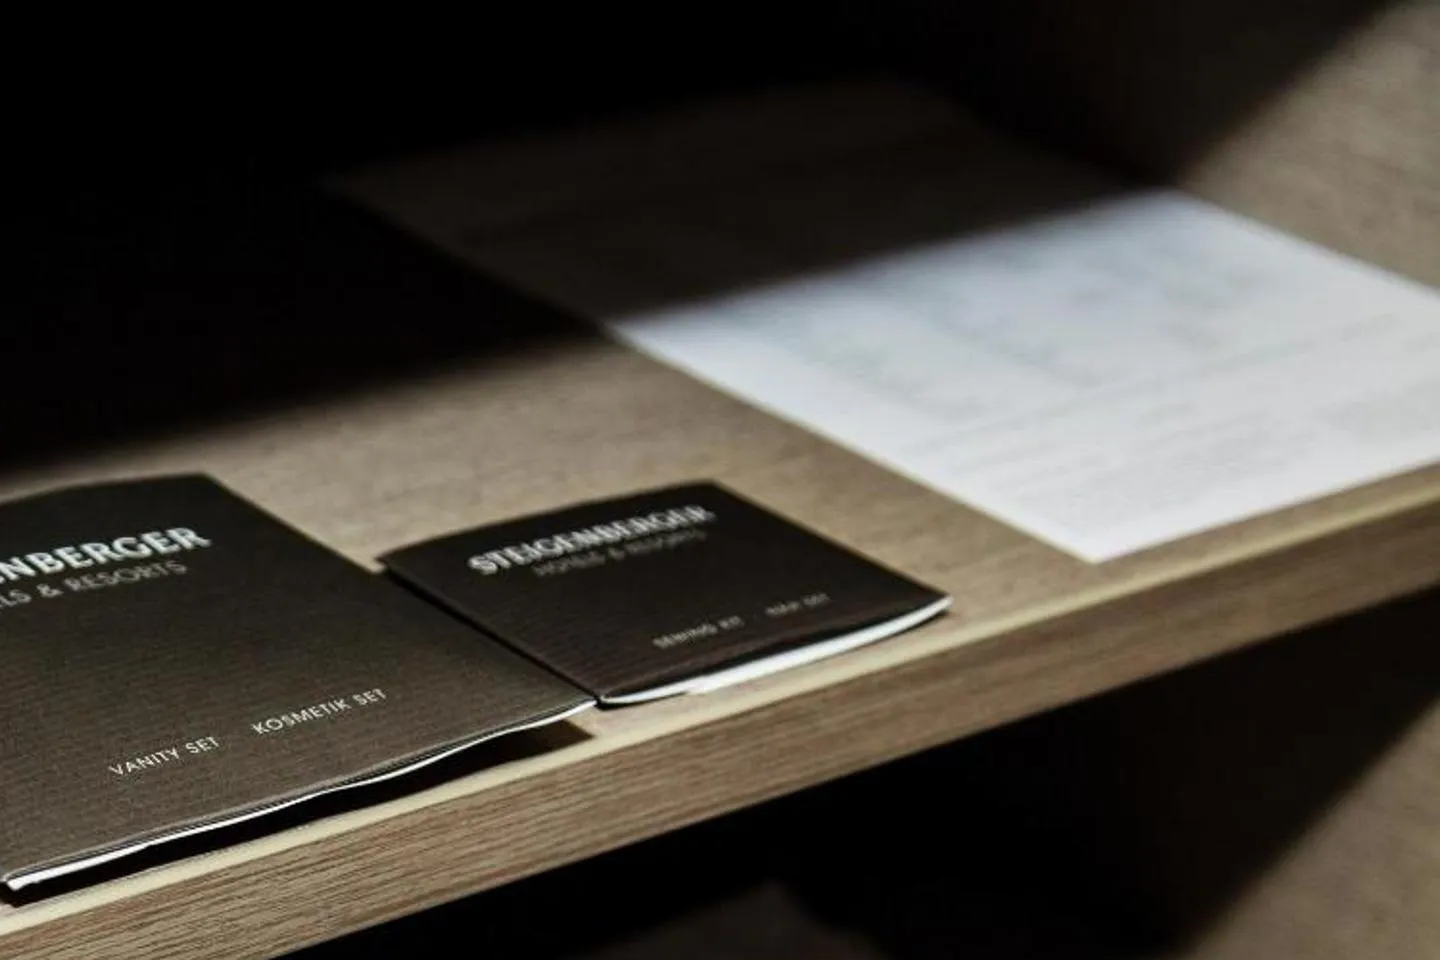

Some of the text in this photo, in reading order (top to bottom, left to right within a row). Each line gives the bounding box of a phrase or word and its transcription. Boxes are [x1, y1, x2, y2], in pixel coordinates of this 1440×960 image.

[38, 581, 64, 598] &
[68, 559, 189, 593] RESORTS
[108, 687, 388, 778] VANITY SET KOSMETIK SET
